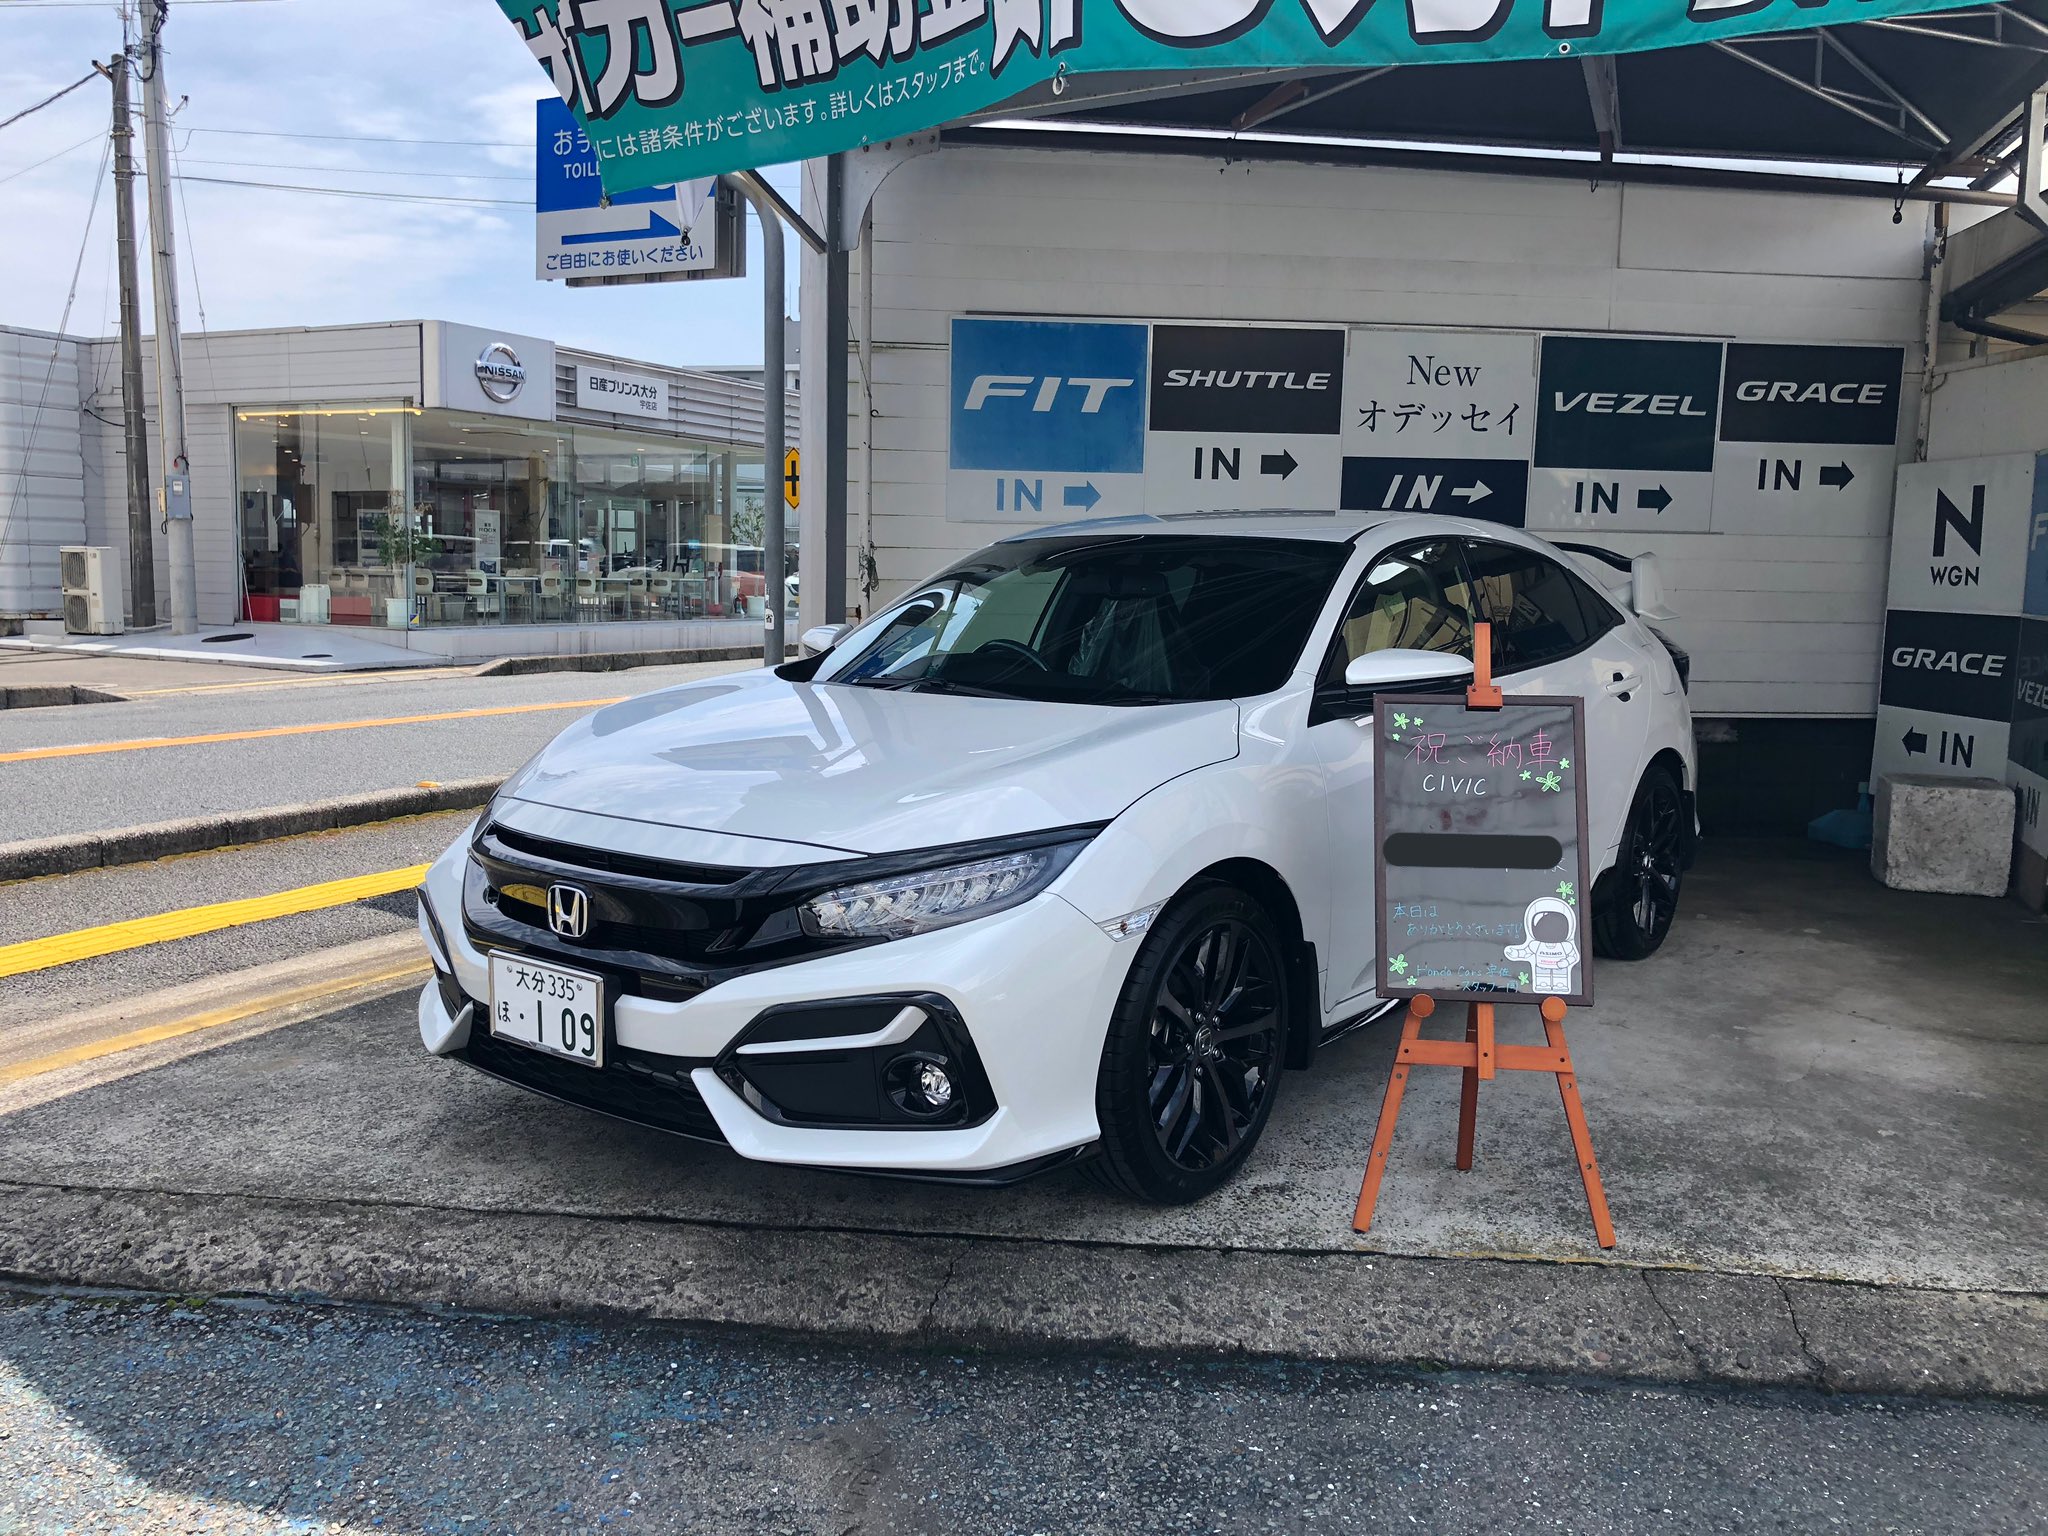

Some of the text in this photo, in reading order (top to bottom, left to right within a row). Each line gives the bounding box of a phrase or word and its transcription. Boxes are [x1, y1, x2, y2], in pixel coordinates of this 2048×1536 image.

[546, 245, 704, 270] ご自由にお使いください
[484, 365, 525, 380] NISSAN
[1163, 369, 1332, 390] SHUTTLE
[1406, 355, 1482, 387] New
[590, 376, 657, 399] 日産プリンス大分
[963, 375, 1134, 413] FIT
[1736, 380, 1888, 405] GRACE
[1357, 400, 1521, 436] オデッセイ
[1555, 391, 1707, 417] VEZEL
[1194, 447, 1241, 481] IN
[1758, 459, 1802, 492] IN
[996, 479, 1043, 512] IN
[1380, 475, 1444, 510] IN
[1574, 481, 1619, 515] IN
[1932, 485, 1986, 557] N
[1930, 565, 1980, 587] WGN
[1891, 647, 2008, 677] GRACE
[1939, 730, 1975, 769] IN
[1422, 774, 1487, 796] CIVIC
[1393, 902, 1439, 919] 本日は
[1416, 965, 1452, 977] Honda
[1457, 965, 1482, 977] Cars
